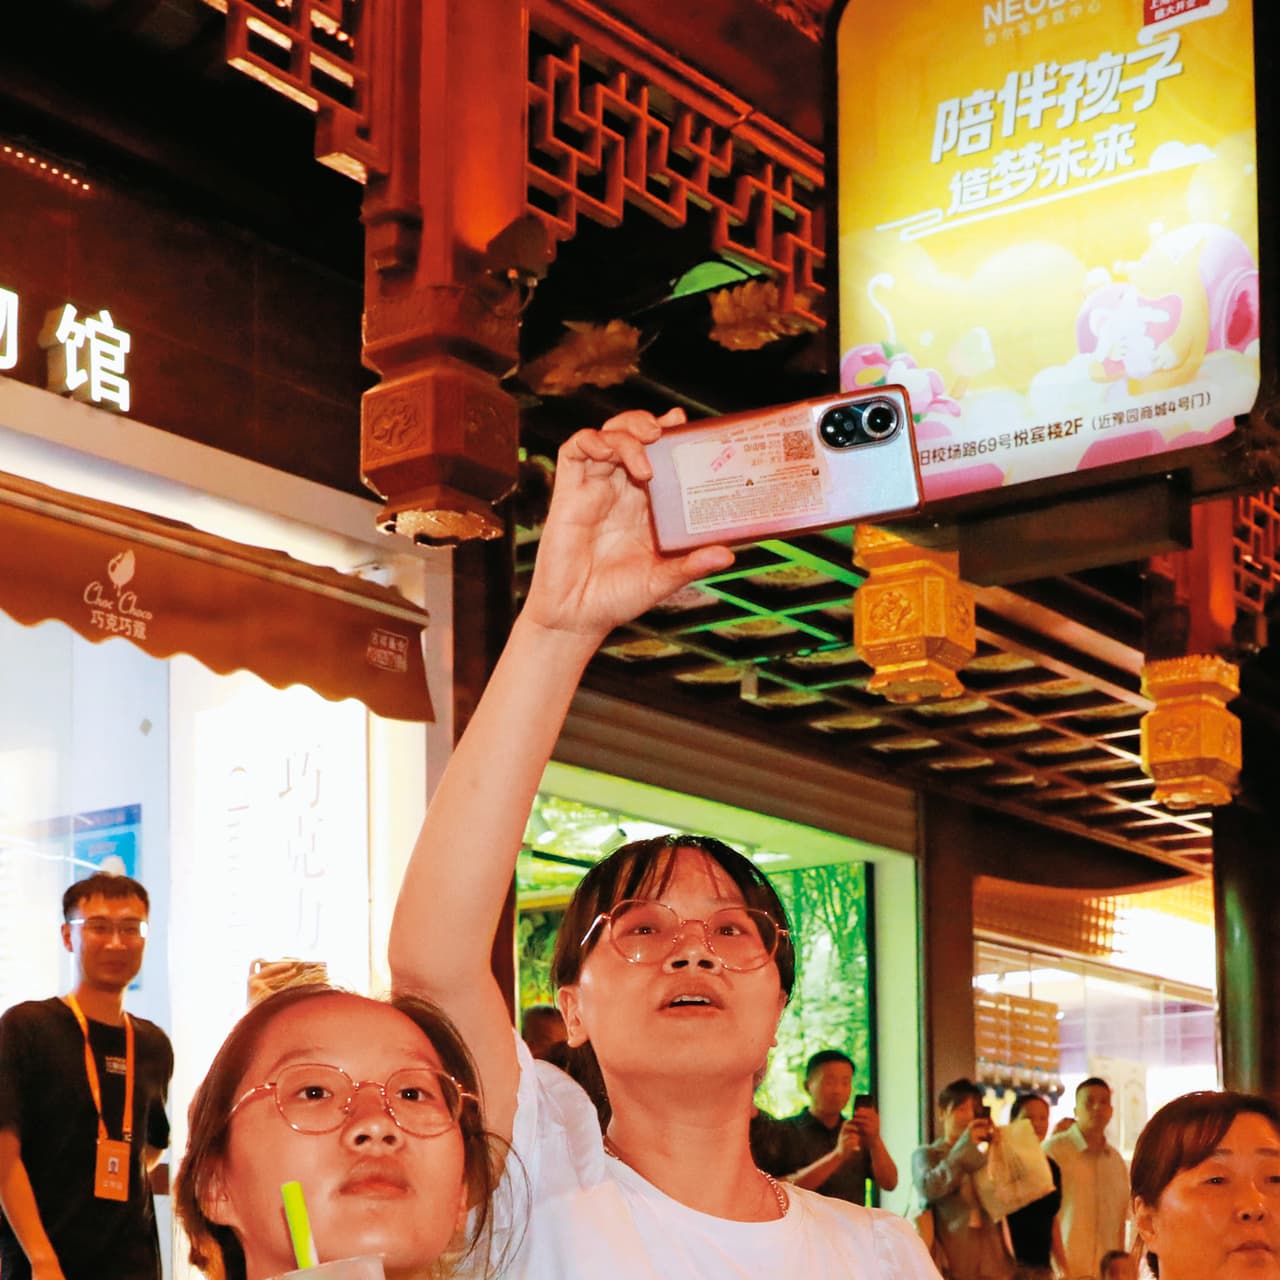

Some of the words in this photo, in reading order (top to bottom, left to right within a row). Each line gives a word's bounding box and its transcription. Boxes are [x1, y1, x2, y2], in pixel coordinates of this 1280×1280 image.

[929, 36, 1183, 163] 陪伴孩子
[948, 122, 1136, 215] 造梦未来
